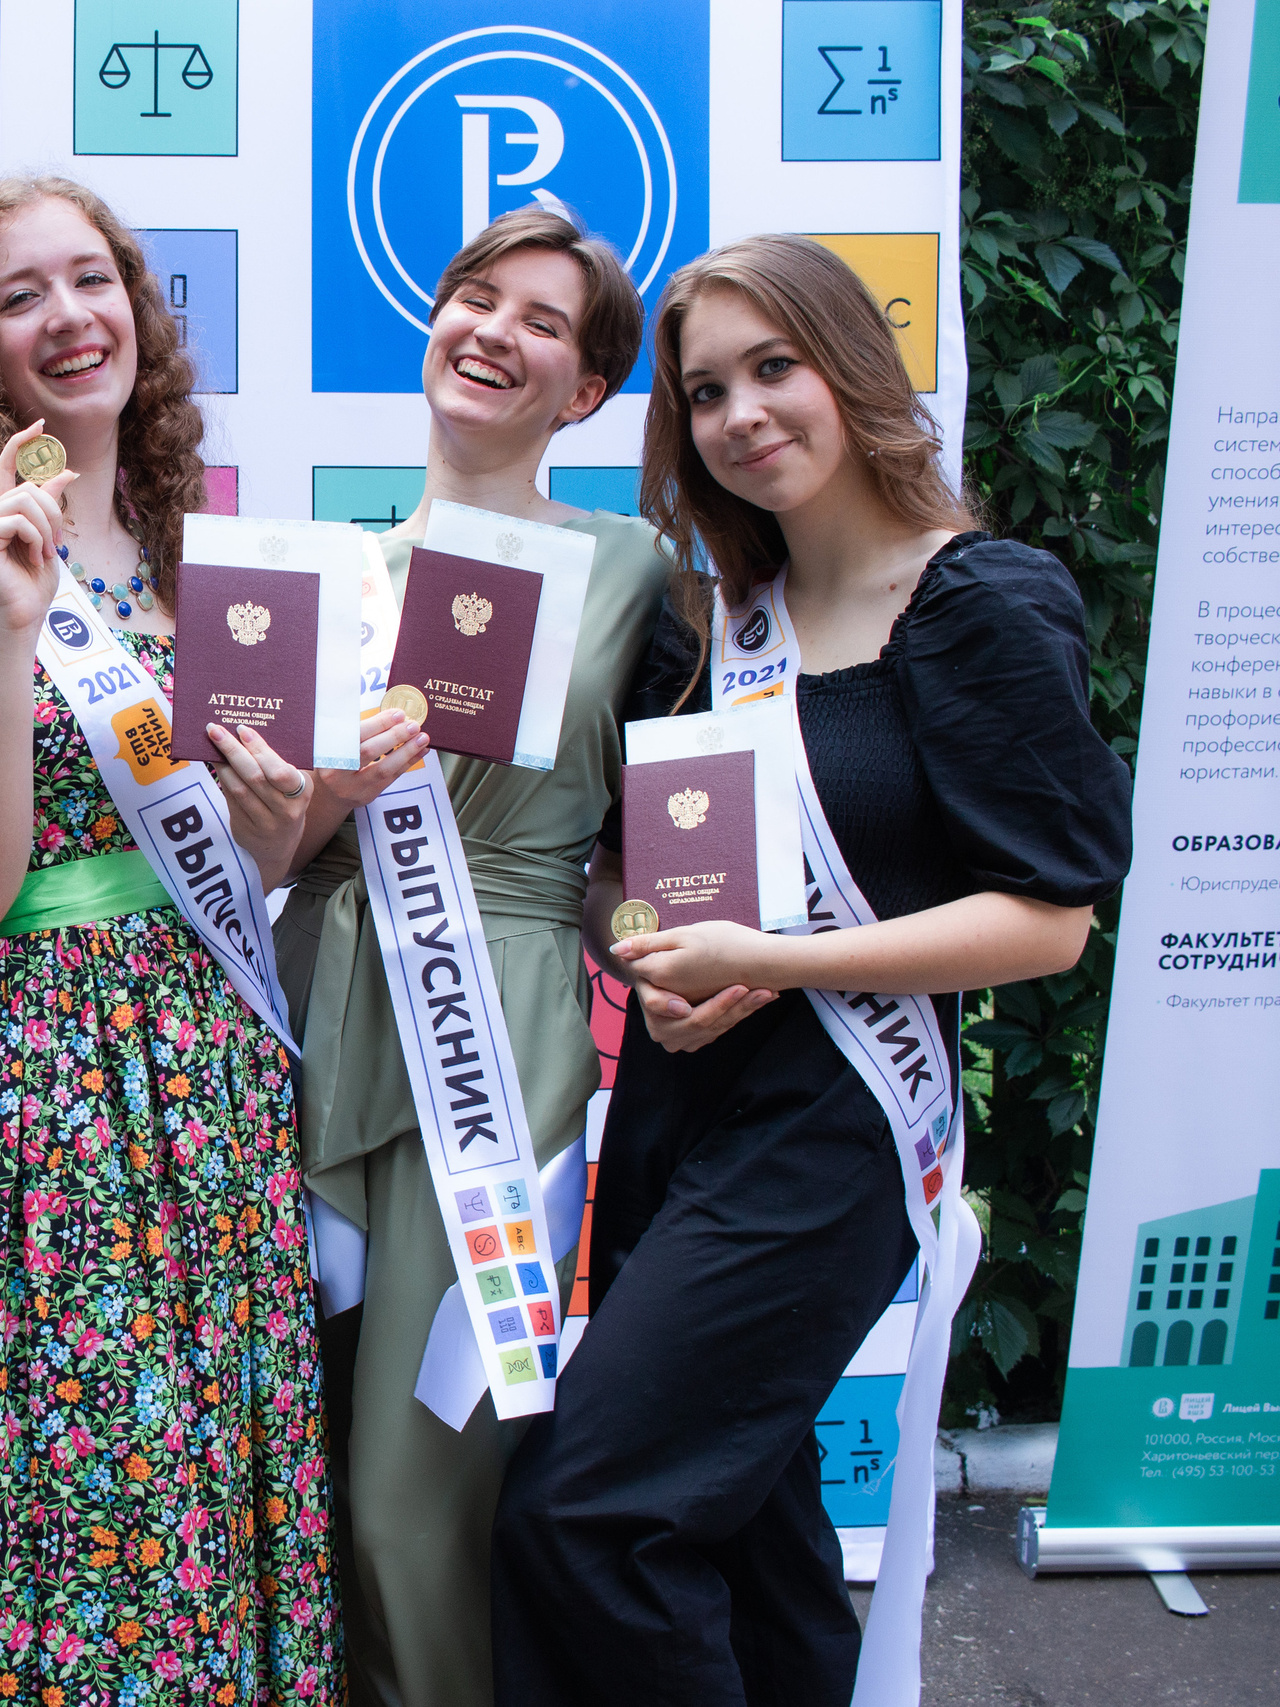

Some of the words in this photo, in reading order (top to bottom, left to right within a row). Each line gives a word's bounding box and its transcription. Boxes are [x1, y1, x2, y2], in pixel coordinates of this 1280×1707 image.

[1217, 406, 1280, 428] Напра
[1207, 495, 1279, 513] умения
[1197, 600, 1210, 618] В
[1194, 632, 1280, 650] творческ
[78, 662, 141, 706] 2021
[722, 657, 788, 696] 2021
[423, 678, 495, 702] АТТЕСТАТ
[1188, 687, 1257, 700] навыки
[1263, 687, 1272, 699] в
[207, 693, 284, 710] АТТЕСТАТ
[434, 695, 462, 706] СРЕДНЕМ
[462, 701, 485, 711] ОБЩЕМ
[434, 702, 477, 716] ОБРАЗОВАНИИ
[221, 710, 251, 718] СРЕДНЕМ
[251, 712, 276, 720] ОБЩЕМ
[221, 717, 268, 727] ОБРАЗОВАНИИ
[125, 727, 151, 766] ВШЭ
[137, 722, 164, 758] НИУ
[1182, 736, 1280, 757] професси
[1179, 767, 1279, 784] юристами.
[1172, 834, 1280, 852] ОБРАЗОВ
[655, 872, 727, 890] АТТЕСТАТ
[1180, 876, 1280, 894] Юриспруде
[1158, 952, 1280, 972] СОТРУДНИ
[382, 804, 500, 1154] ВЫПУСКНИК
[1166, 994, 1250, 1012] Факультет
[1222, 1403, 1261, 1413] Лицей
[1262, 1402, 1280, 1412] Вы
[1145, 1433, 1192, 1445] 101000,
[1195, 1433, 1245, 1444] Россия,
[1141, 1449, 1251, 1463] Харитоньевский
[1172, 1465, 1206, 1479] (495)
[1209, 1464, 1275, 1477] 53-100-53
